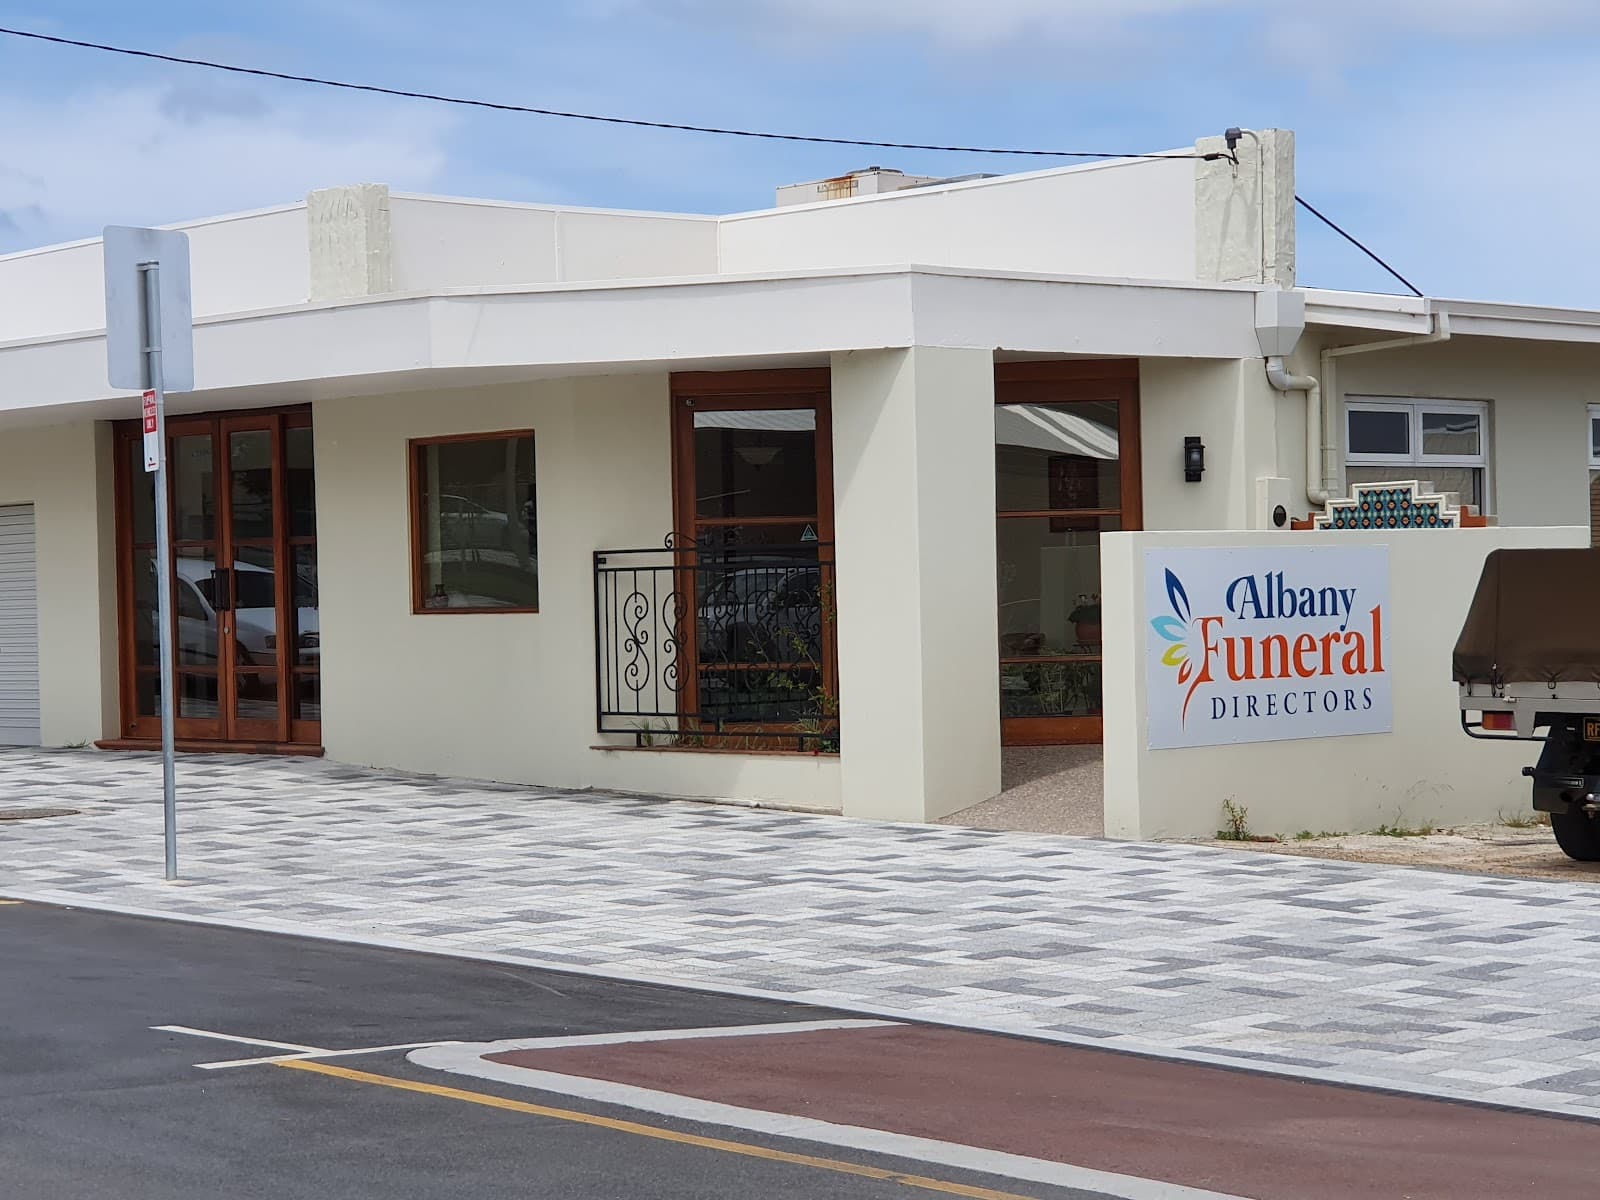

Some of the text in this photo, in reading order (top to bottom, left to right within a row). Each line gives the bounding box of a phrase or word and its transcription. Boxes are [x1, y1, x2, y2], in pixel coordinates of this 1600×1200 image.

[1226, 570, 1357, 632] Albany
[1191, 604, 1385, 683] Funeral
[1211, 687, 1373, 720] DIRECTORS
